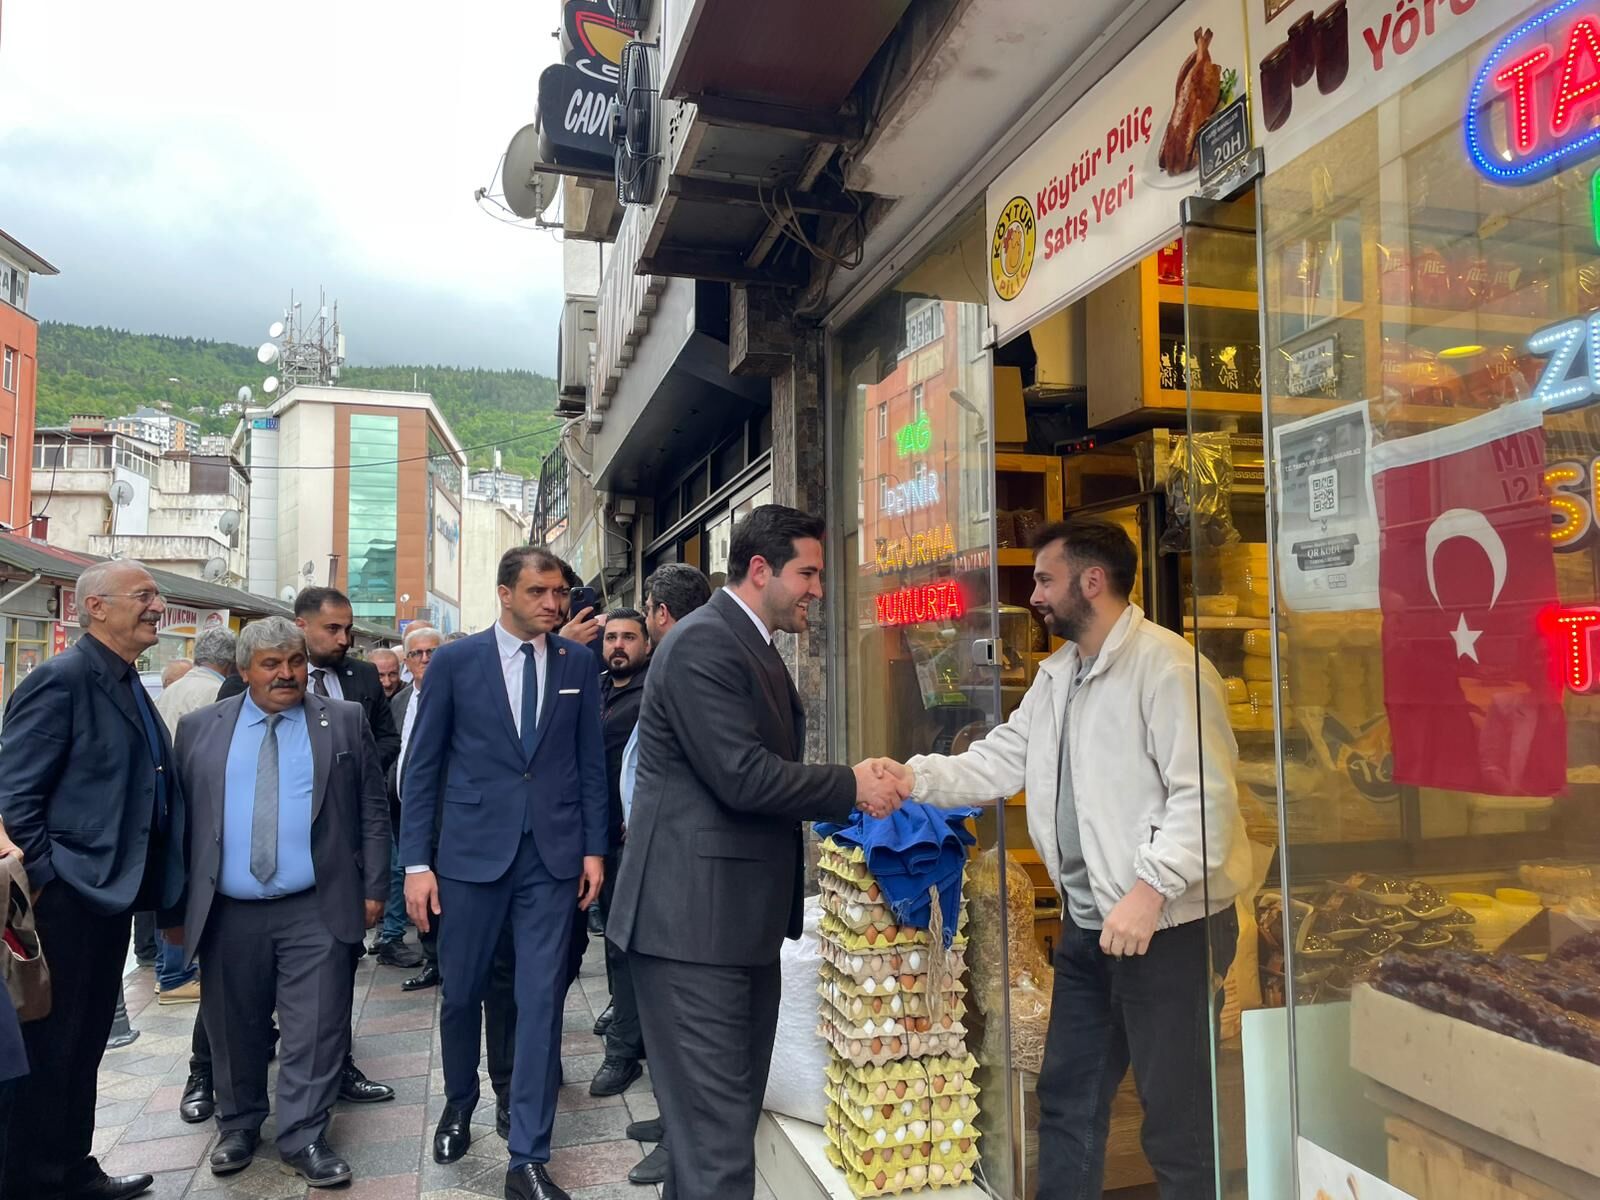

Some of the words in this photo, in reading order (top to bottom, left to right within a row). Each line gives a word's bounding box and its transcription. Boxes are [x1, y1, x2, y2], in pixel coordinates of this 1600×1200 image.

[1362, 0, 1475, 71] Yör
[1036, 148, 1102, 221] Köytür
[1106, 105, 1153, 164] Piliç
[1214, 131, 1241, 168] 20H
[993, 203, 1032, 259] KÖYTÜR
[1044, 208, 1089, 262] Satış
[1091, 163, 1134, 224] Yeri
[894, 408, 931, 458] YAĞ
[886, 462, 940, 515] PEYNİR
[875, 521, 957, 575] KAVURMA
[874, 579, 963, 626] YUMURTA
